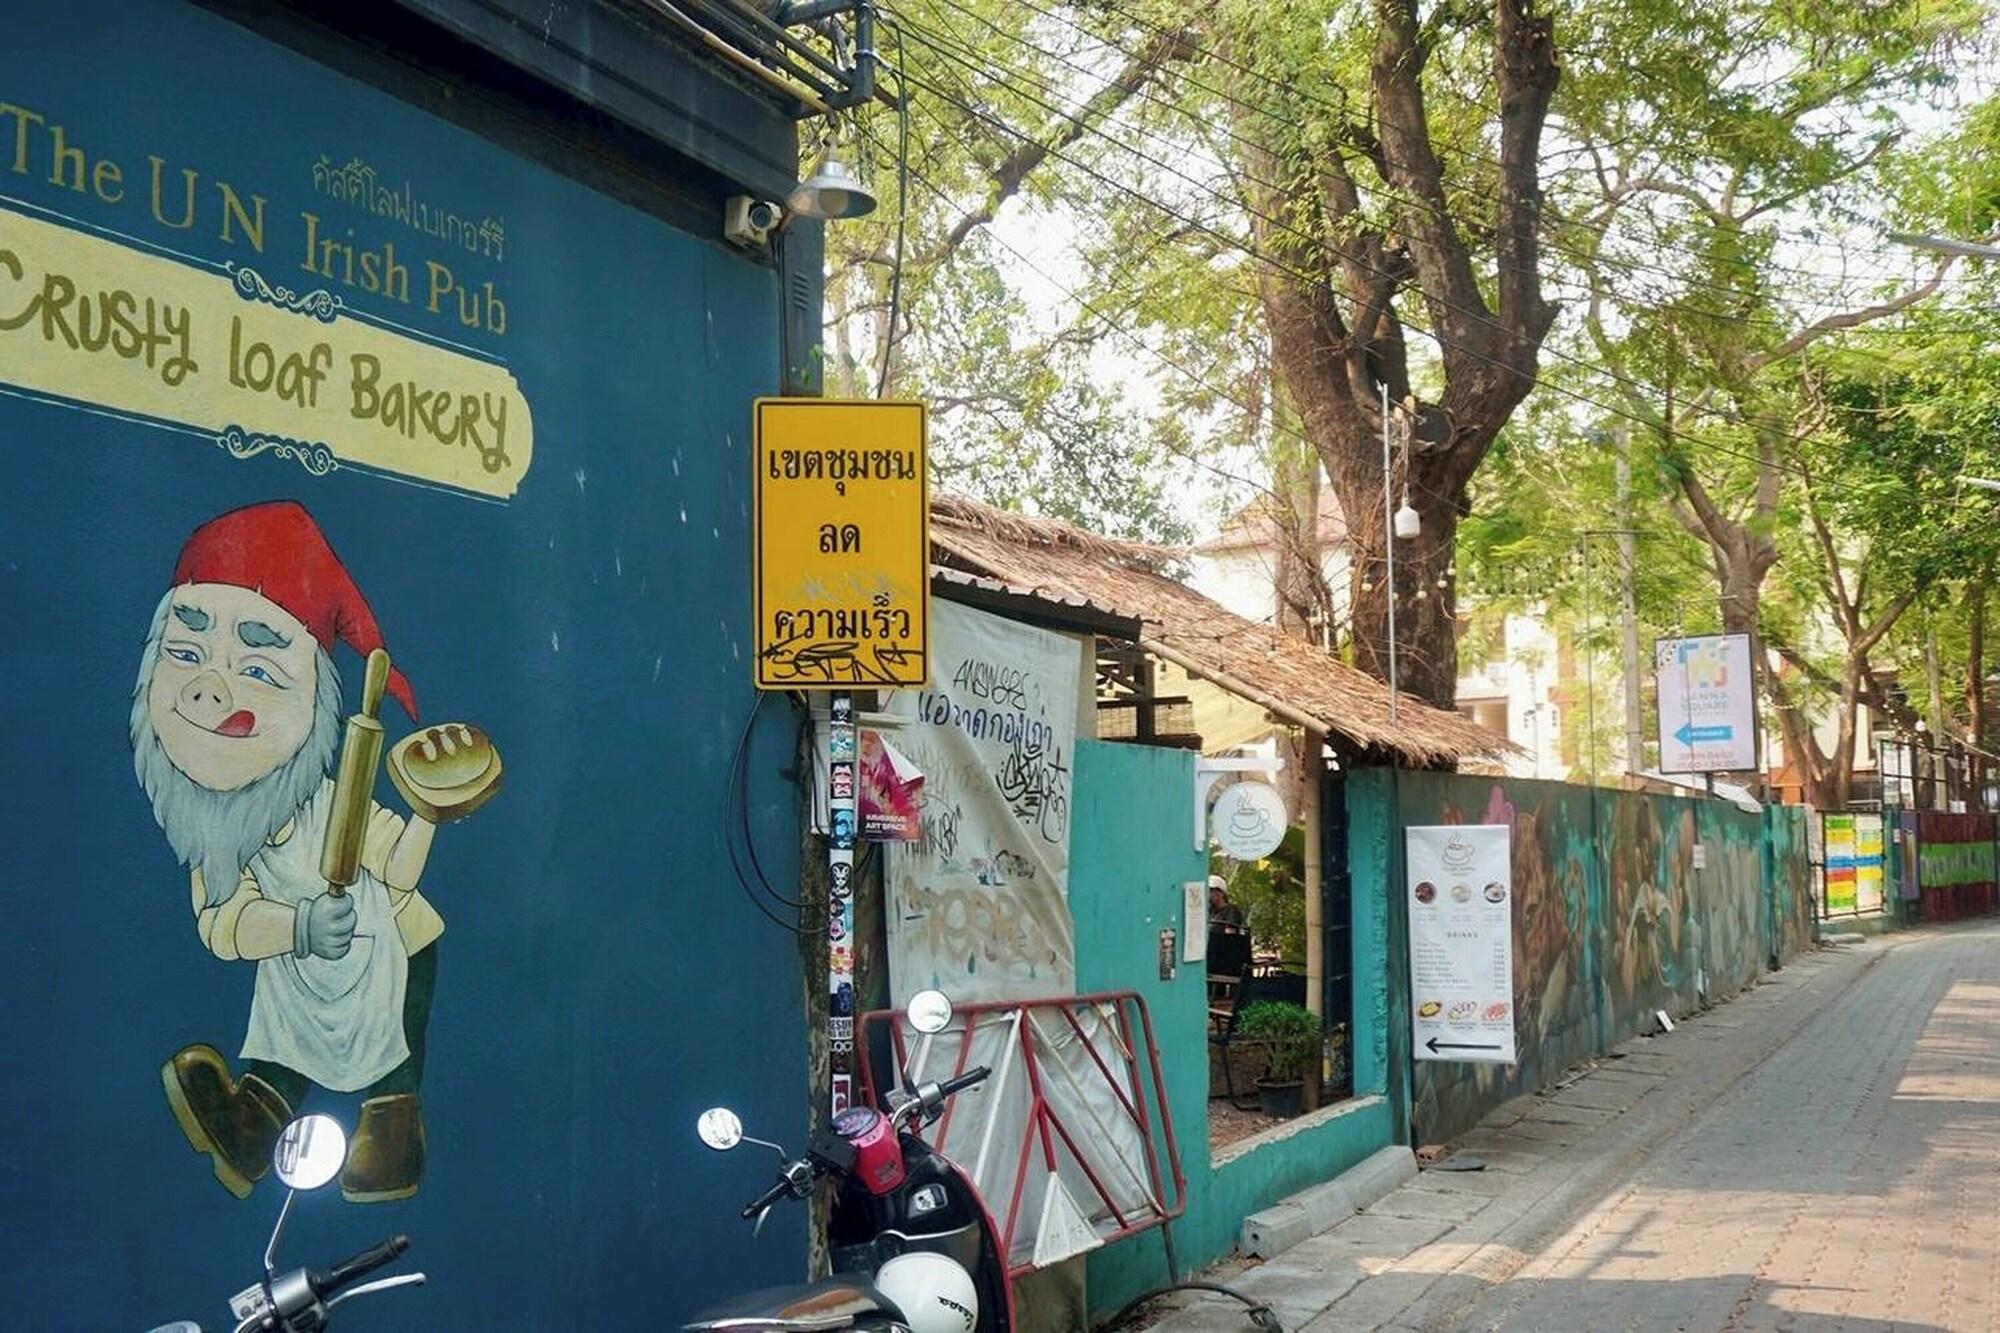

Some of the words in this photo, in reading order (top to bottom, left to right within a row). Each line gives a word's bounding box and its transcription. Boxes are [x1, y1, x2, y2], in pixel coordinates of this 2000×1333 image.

[0, 102, 124, 203] The
[301, 211, 410, 304] Irish
[425, 260, 507, 336] Pub
[769, 449, 916, 496] เขตชุมชน
[819, 522, 861, 553] ลด
[774, 591, 910, 639] ความเร็ว
